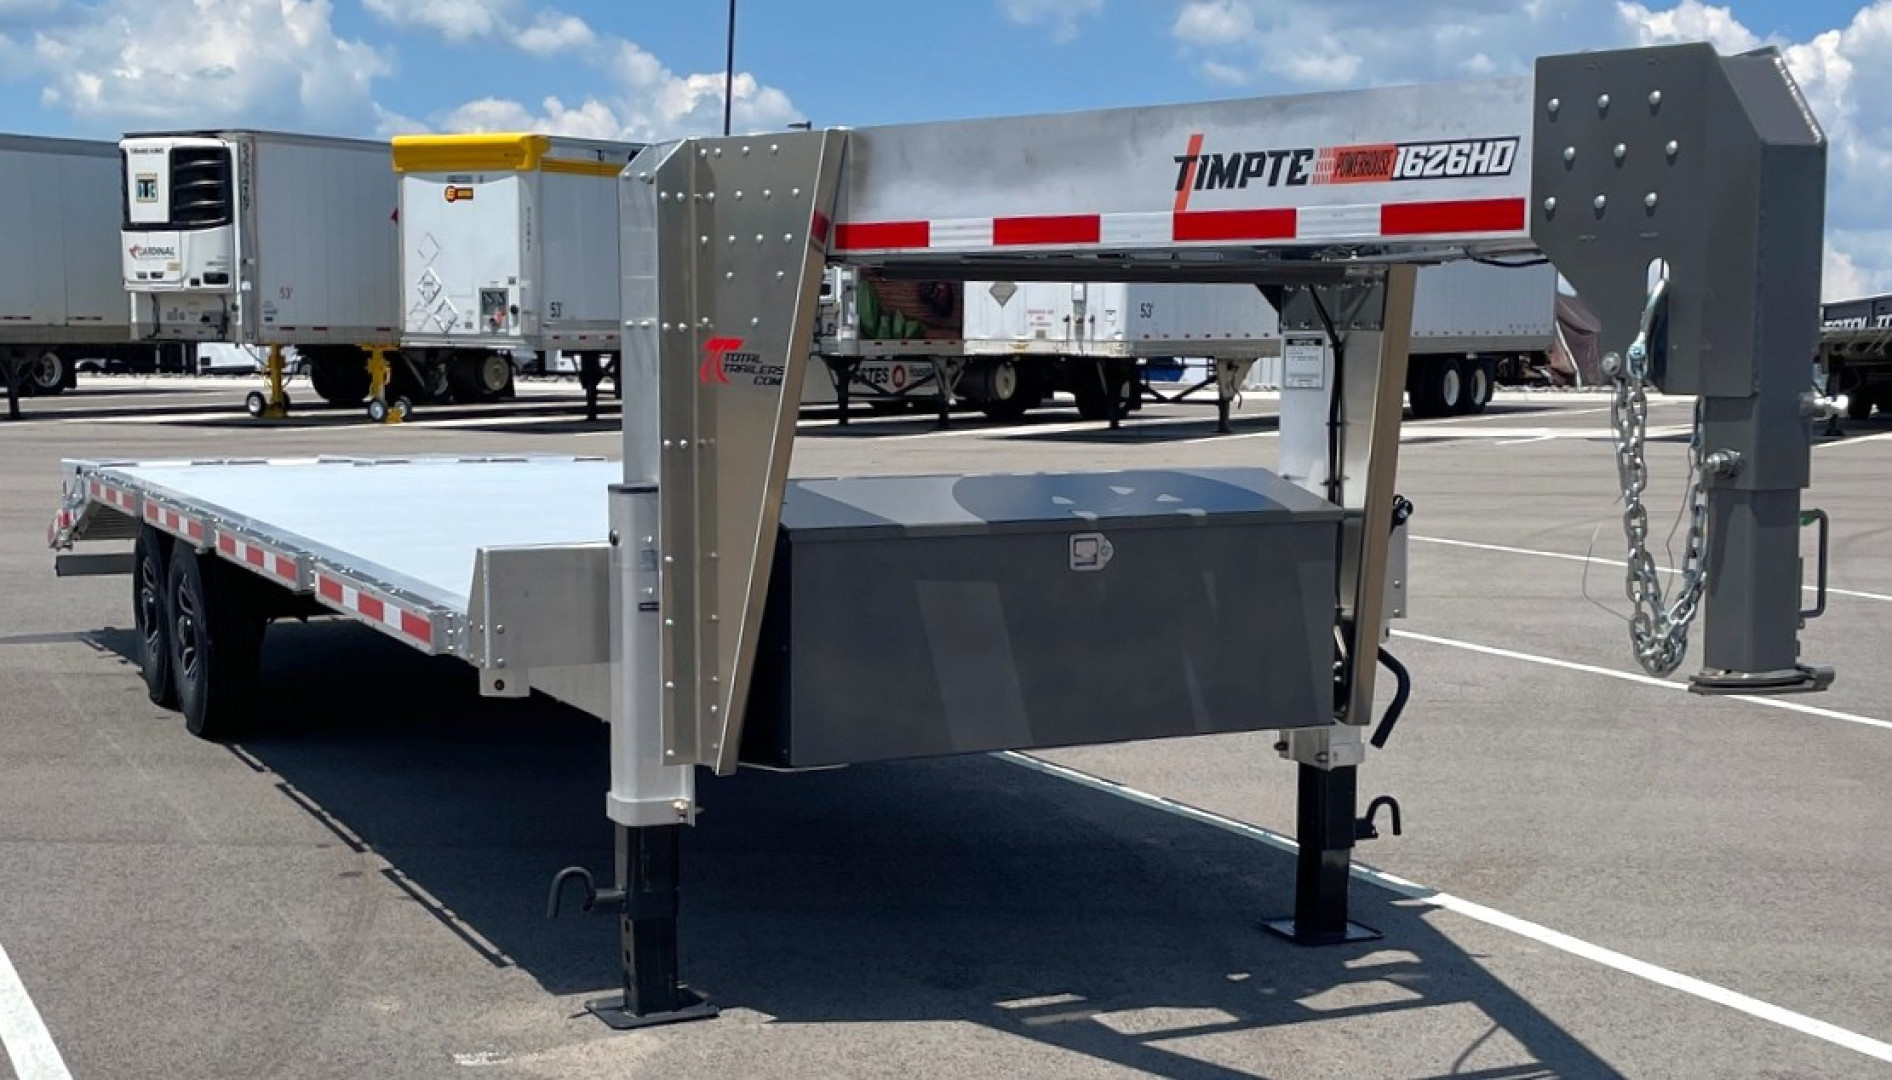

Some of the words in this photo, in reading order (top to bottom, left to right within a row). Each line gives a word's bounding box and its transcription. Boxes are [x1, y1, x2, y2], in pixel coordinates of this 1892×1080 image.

[1174, 142, 1314, 198] TIMPTE
[1393, 138, 1516, 179] 1626HD
[1140, 302, 1154, 318] 53'
[725, 352, 762, 364] TOTAL
[723, 363, 785, 376] TRAILERS
